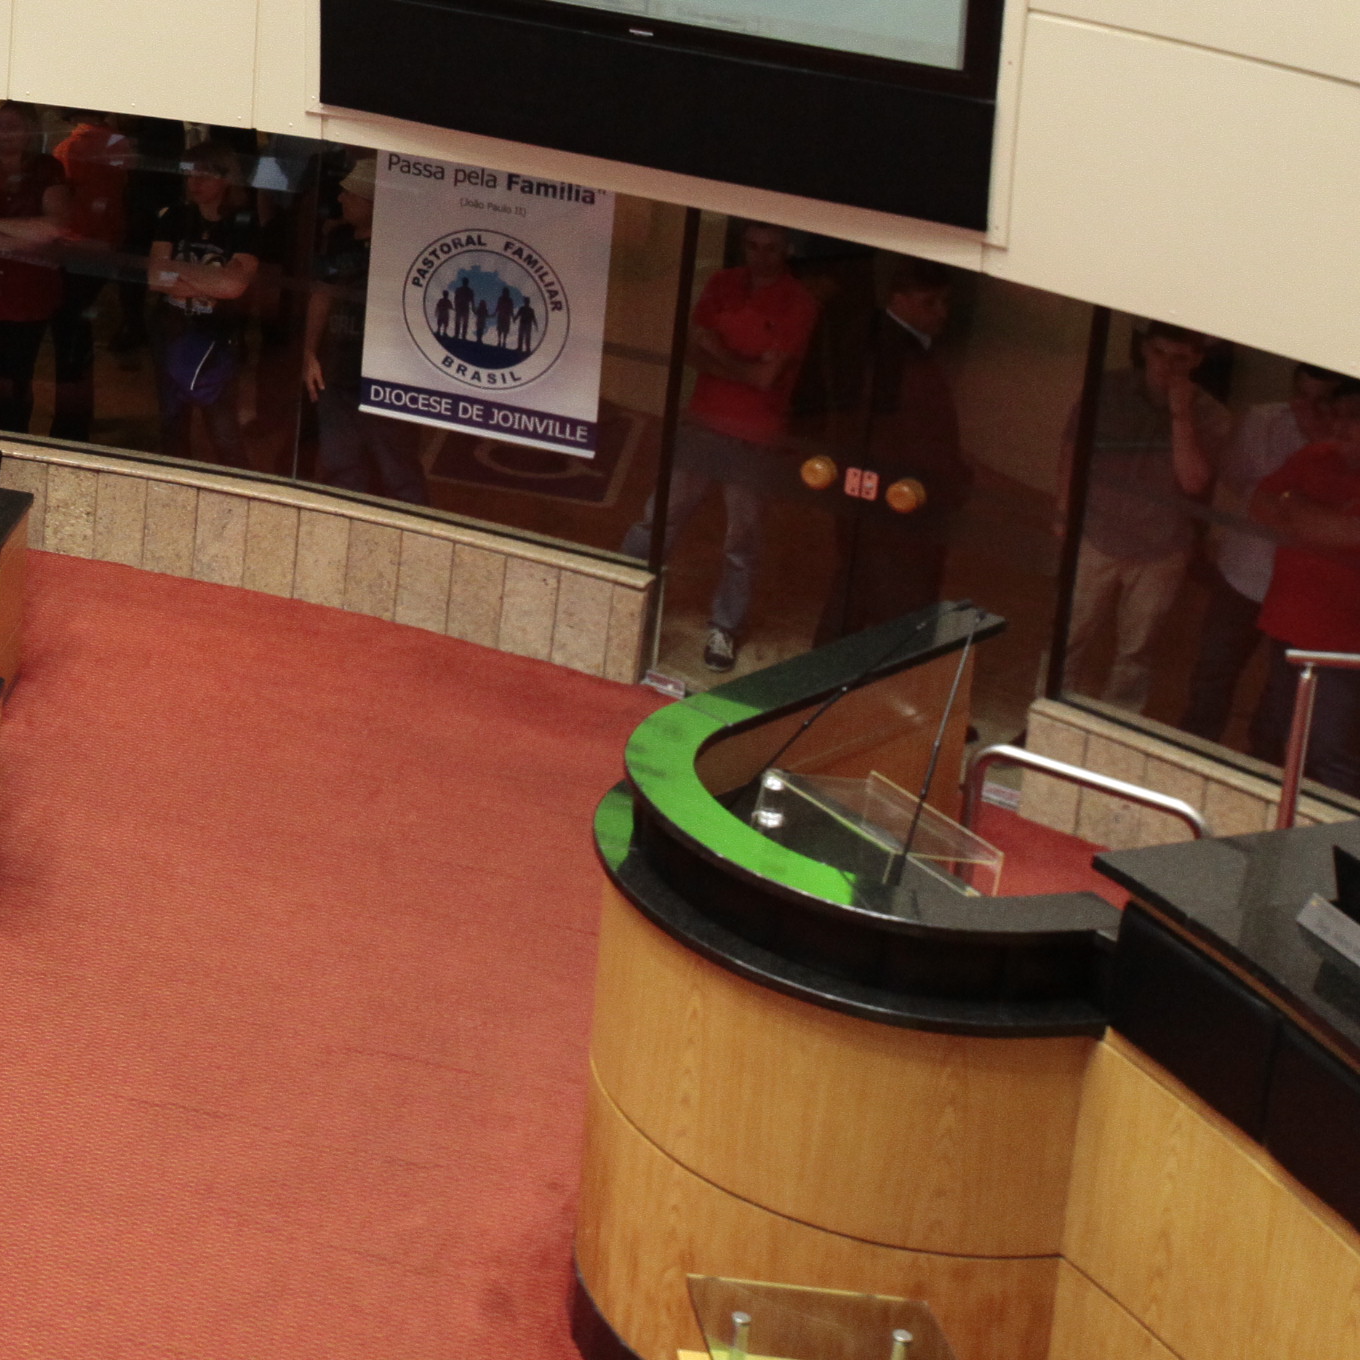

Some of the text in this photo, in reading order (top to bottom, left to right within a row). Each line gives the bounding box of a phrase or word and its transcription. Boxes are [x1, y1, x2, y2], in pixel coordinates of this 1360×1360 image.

[387, 153, 446, 180] Passa
[453, 165, 498, 189] pela
[412, 233, 564, 312] PASTORAL FAMILIAR
[441, 355, 522, 385] BRASIL
[370, 385, 589, 442] DIOCESE DE JOINVILLE
